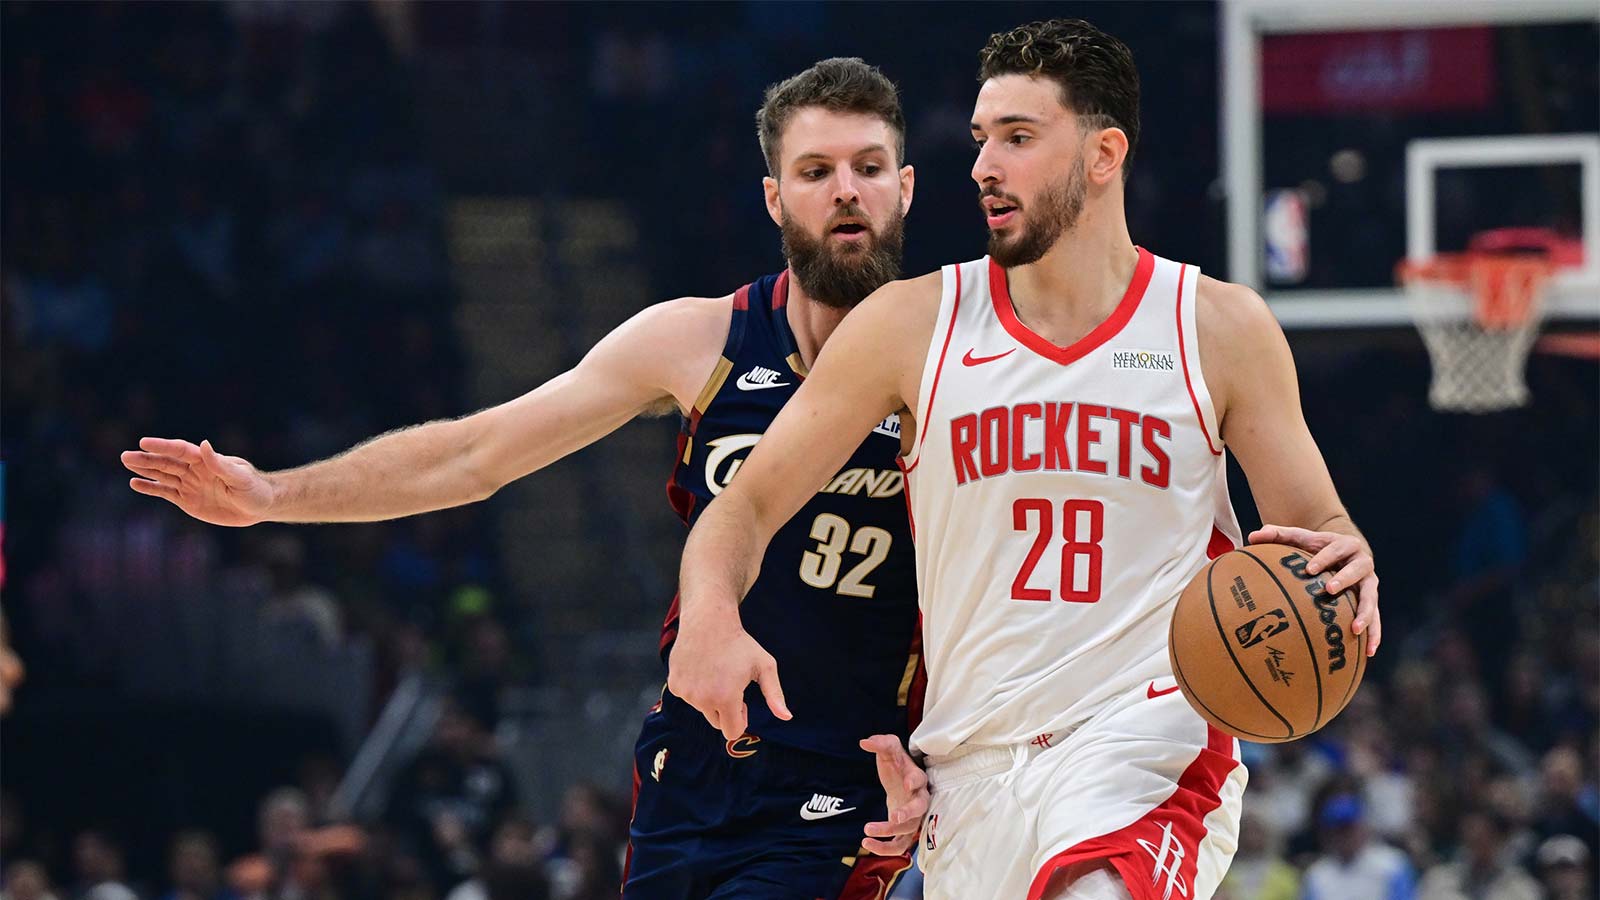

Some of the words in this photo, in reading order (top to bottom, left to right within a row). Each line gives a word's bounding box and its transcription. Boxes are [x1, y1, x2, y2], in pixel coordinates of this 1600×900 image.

[1113, 352, 1174, 363] MEMORIAL
[1113, 359, 1174, 370] HERMANN
[746, 365, 781, 384] NIKE
[950, 401, 1172, 490] ROCKETS
[799, 512, 893, 599] 32
[1010, 498, 1105, 604] 28
[808, 793, 844, 812] NIKE
